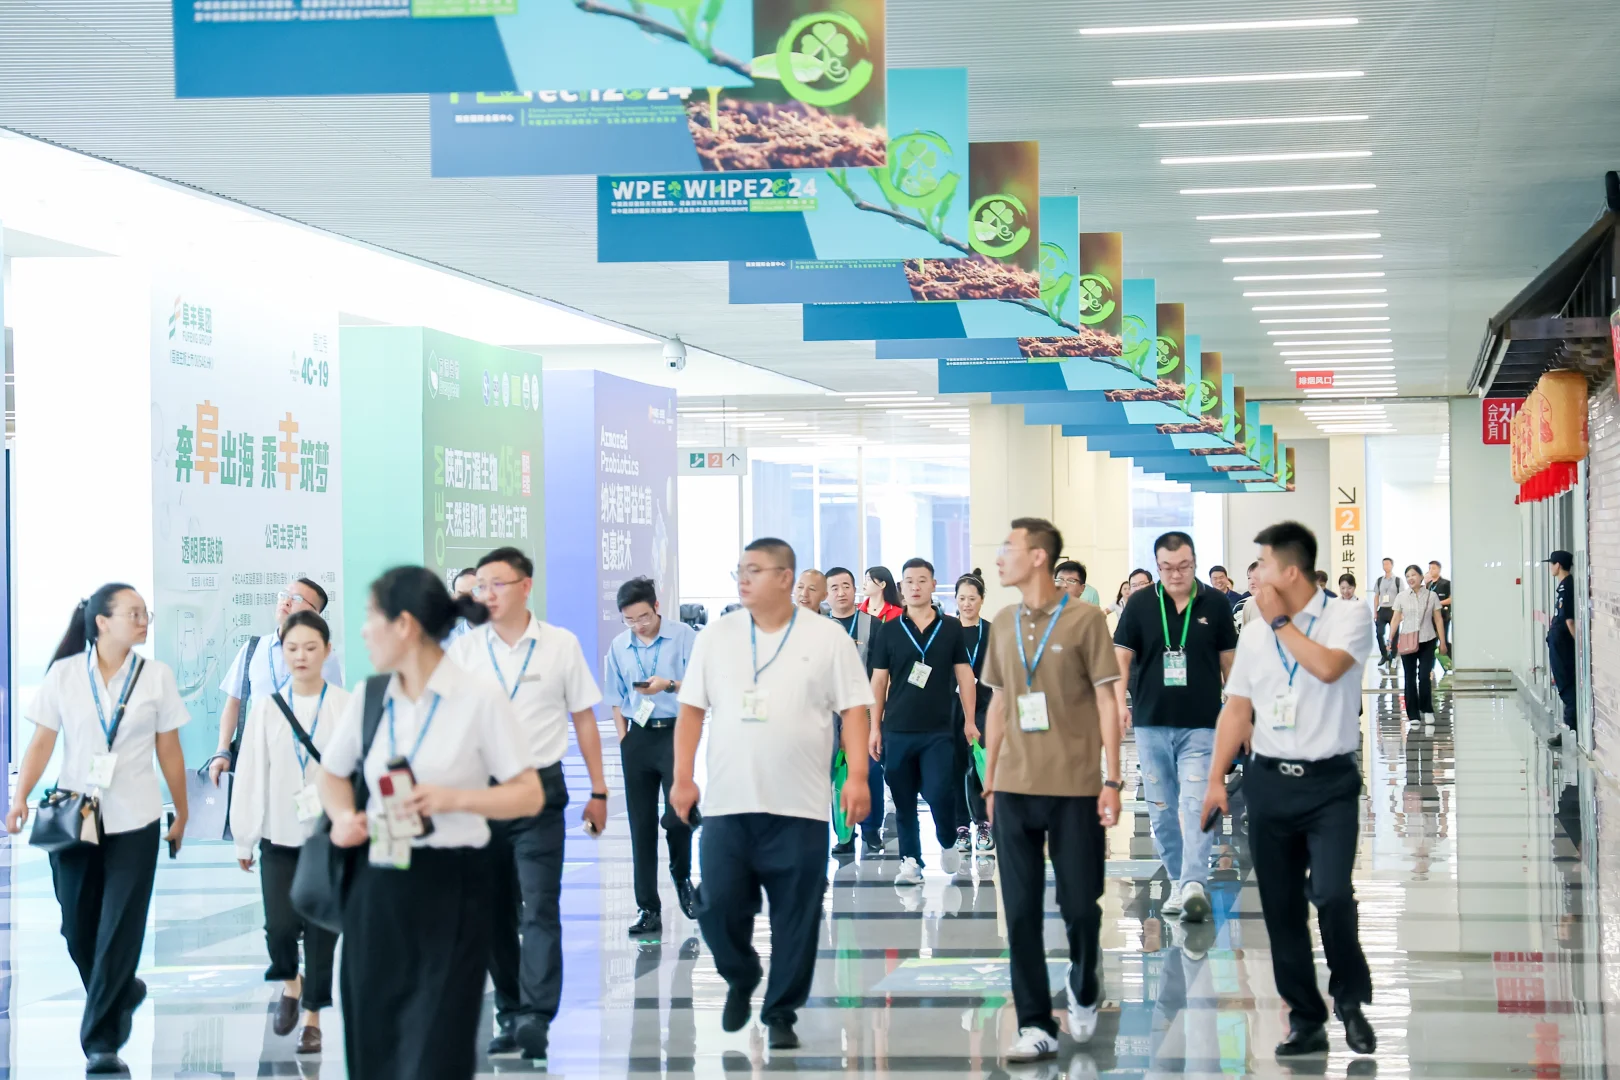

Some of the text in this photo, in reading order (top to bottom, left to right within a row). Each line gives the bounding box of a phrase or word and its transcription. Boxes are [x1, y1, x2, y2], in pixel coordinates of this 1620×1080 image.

[612, 180, 666, 200] WPE
[301, 357, 329, 388] 4C-19
[1299, 376, 1332, 385] 排烟风口
[600, 450, 639, 477] Probiotics
[711, 454, 721, 467] 2
[445, 501, 487, 538] 天然提取物
[1340, 509, 1355, 529] 2
[265, 523, 308, 550] 公司主要产品
[181, 536, 224, 565] 透明质酸钠
